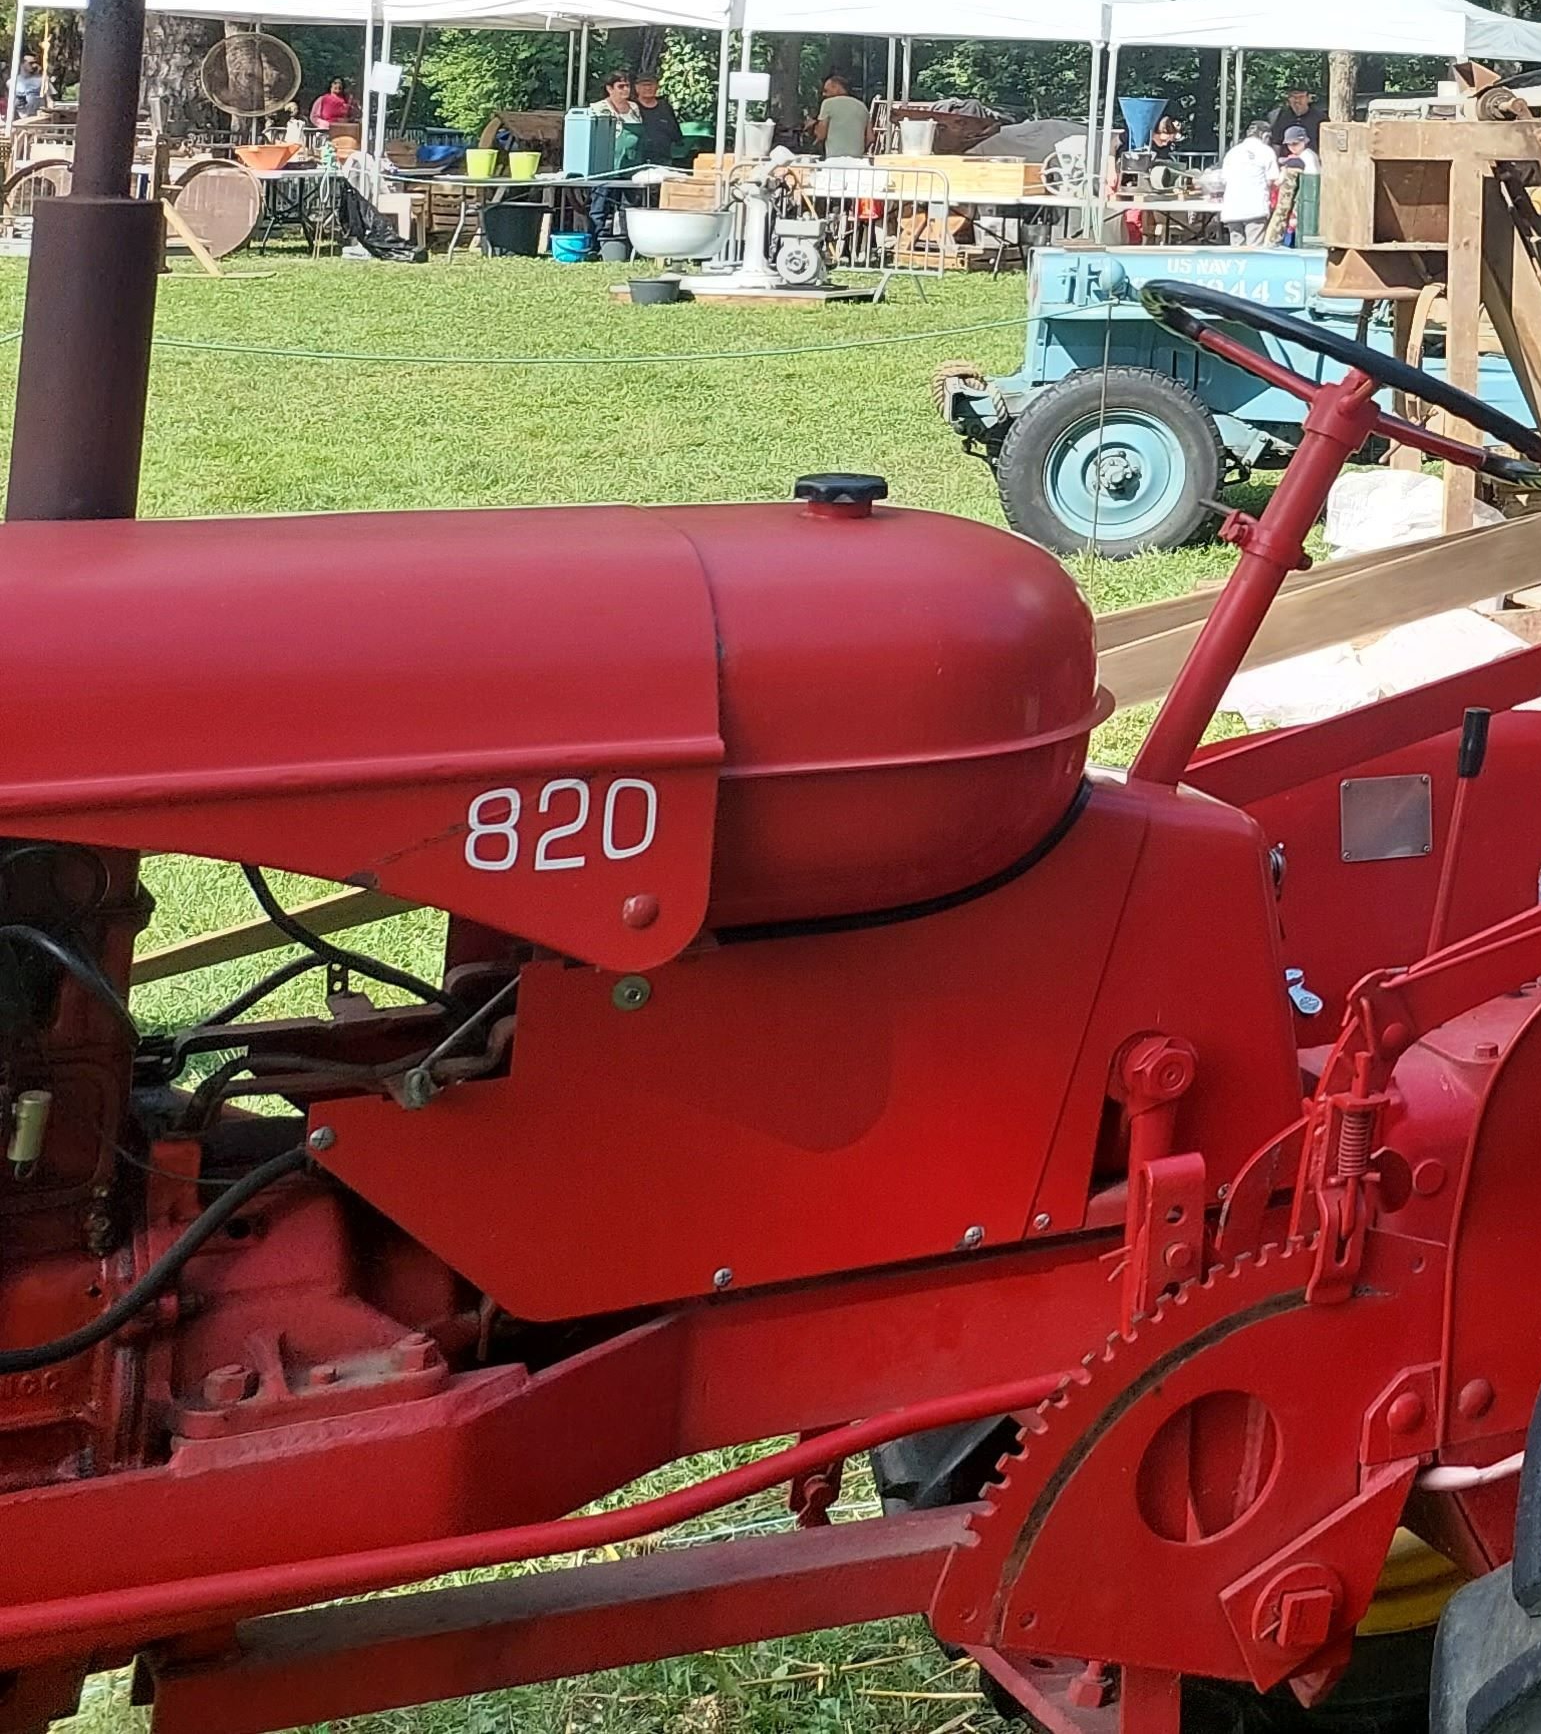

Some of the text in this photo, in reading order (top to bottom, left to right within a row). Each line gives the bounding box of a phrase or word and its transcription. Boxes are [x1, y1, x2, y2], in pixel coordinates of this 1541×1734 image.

[1167, 258, 1248, 275] US NAVY
[464, 778, 658, 871] 820
